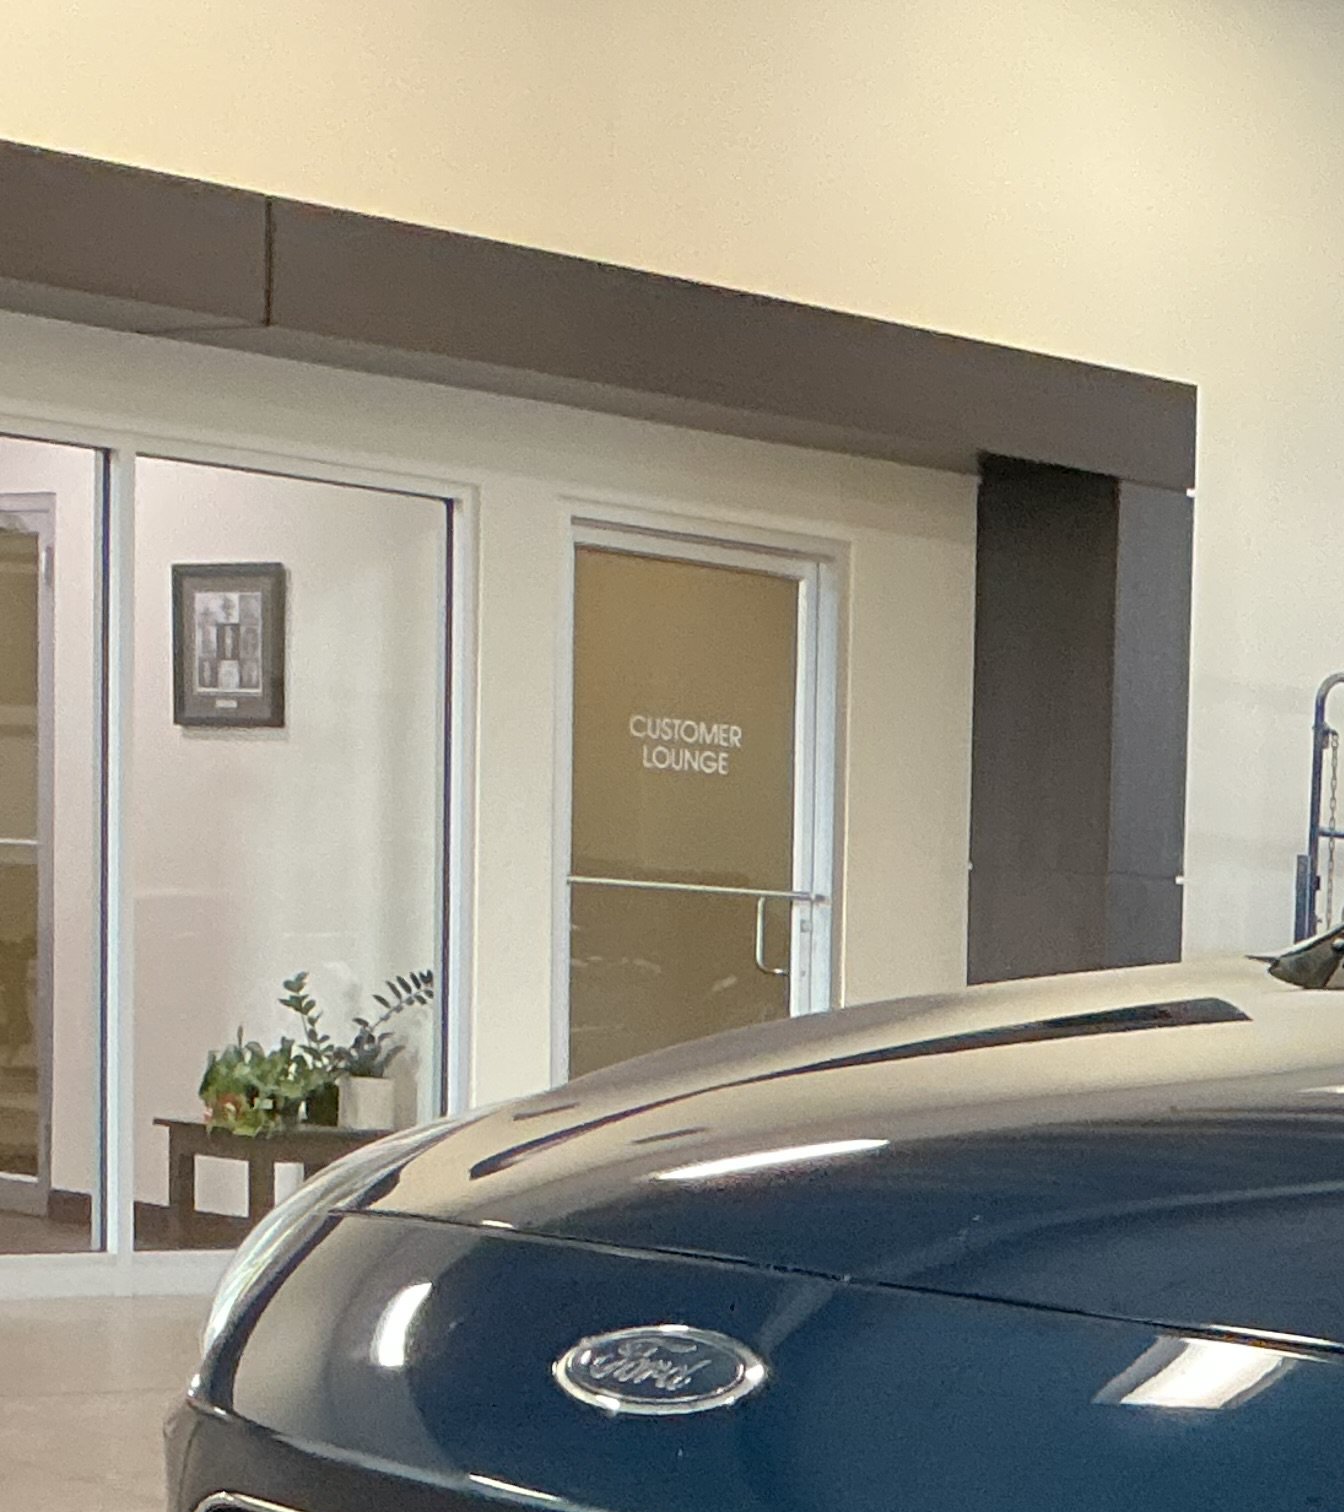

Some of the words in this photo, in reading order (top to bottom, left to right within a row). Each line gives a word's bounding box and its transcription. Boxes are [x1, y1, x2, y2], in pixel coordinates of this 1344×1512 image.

[629, 714, 742, 748] CUSTOMER
[642, 745, 729, 775] LOUNGE
[589, 1337, 713, 1391] Ford
